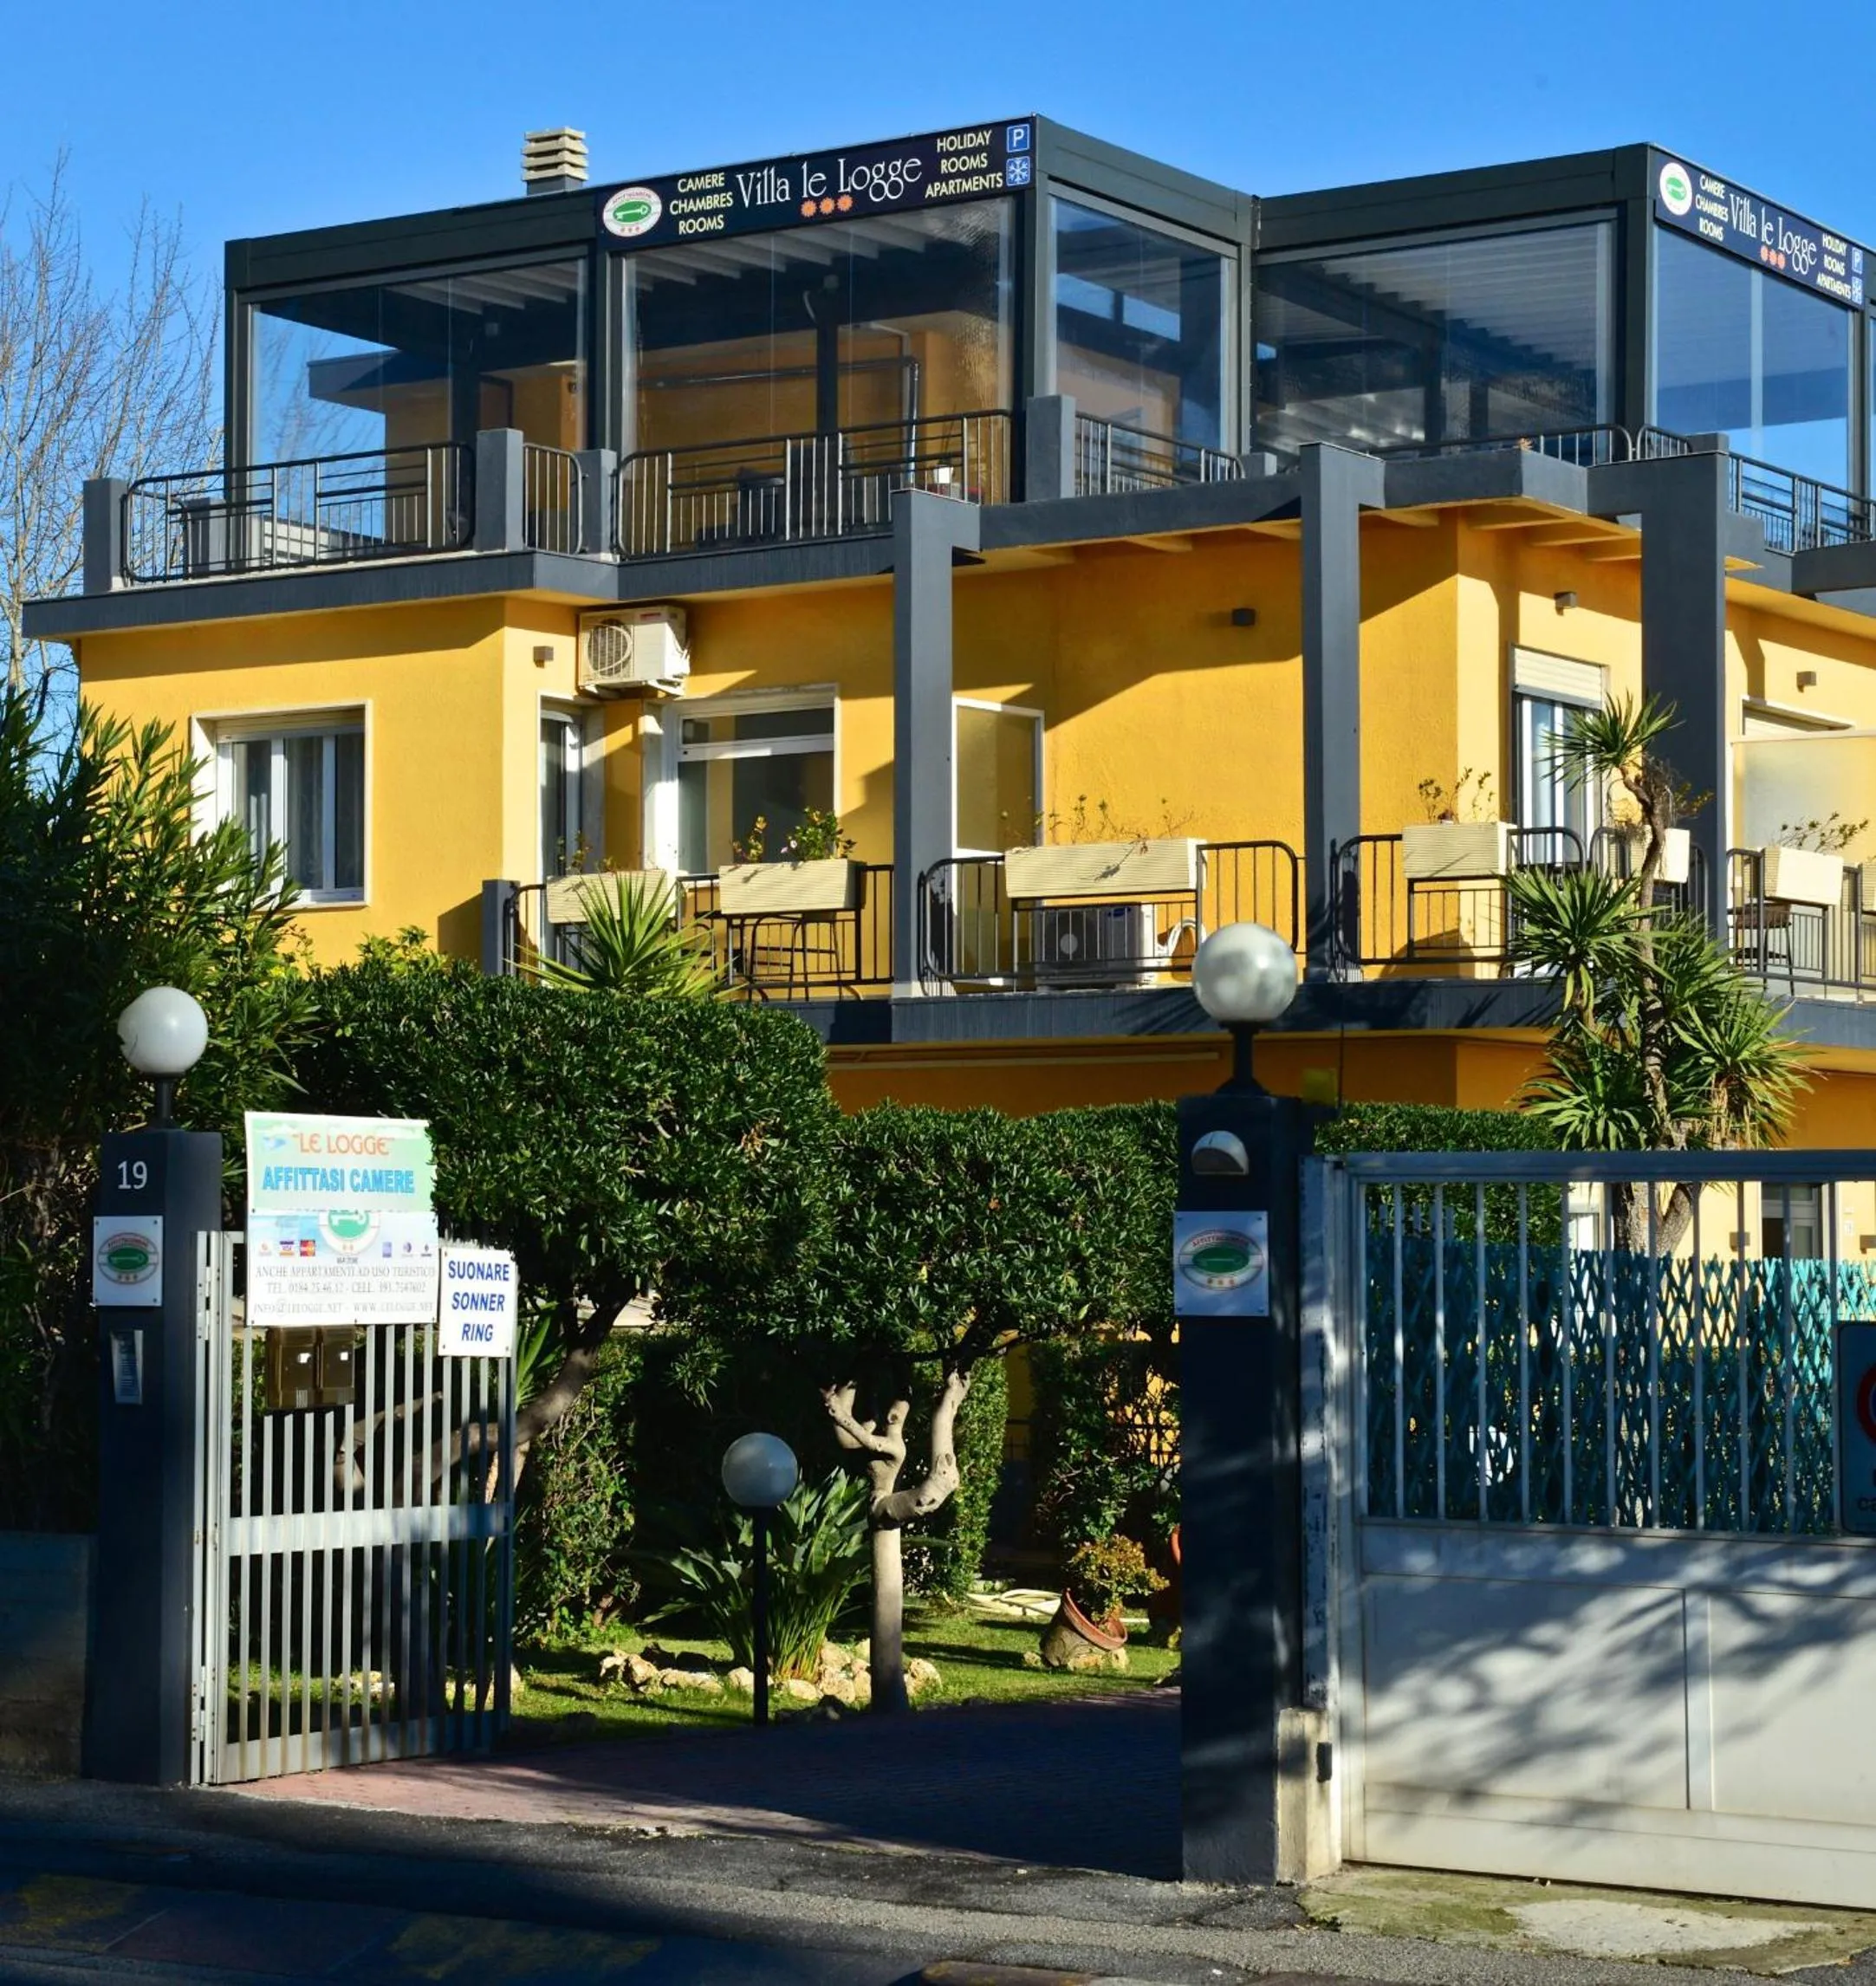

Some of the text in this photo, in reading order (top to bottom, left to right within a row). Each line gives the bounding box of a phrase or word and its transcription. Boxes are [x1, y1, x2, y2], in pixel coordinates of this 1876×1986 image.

[937, 130, 992, 153] HOLIDAY
[1013, 128, 1024, 146] P
[940, 153, 988, 174] ROOMS
[678, 172, 725, 193] CAMERE
[737, 158, 922, 208] Villa le Logge
[925, 172, 1003, 199] APARTMENTS
[1699, 174, 1725, 199] CAMERE
[669, 191, 733, 215] CHAMBRES
[1696, 195, 1729, 223] CHAMBRES
[678, 214, 725, 235] ROOMS
[1699, 217, 1724, 242] ROOMS
[1730, 193, 1817, 276] Villa le Logge
[1821, 232, 1847, 256] HOLIDAY
[1823, 254, 1846, 276] ROOMS
[1816, 273, 1852, 301] APARTMENTS
[118, 1160, 147, 1190] 19
[263, 1166, 415, 1194] AFFITTASI CAMERE
[256, 1265, 289, 1278] ANCHE
[291, 1265, 355, 1278] APPARTAMENTI
[371, 1265, 390, 1277] USO
[448, 1260, 510, 1282] SUONARE
[451, 1292, 505, 1312] SONNER
[461, 1323, 494, 1342] RING
